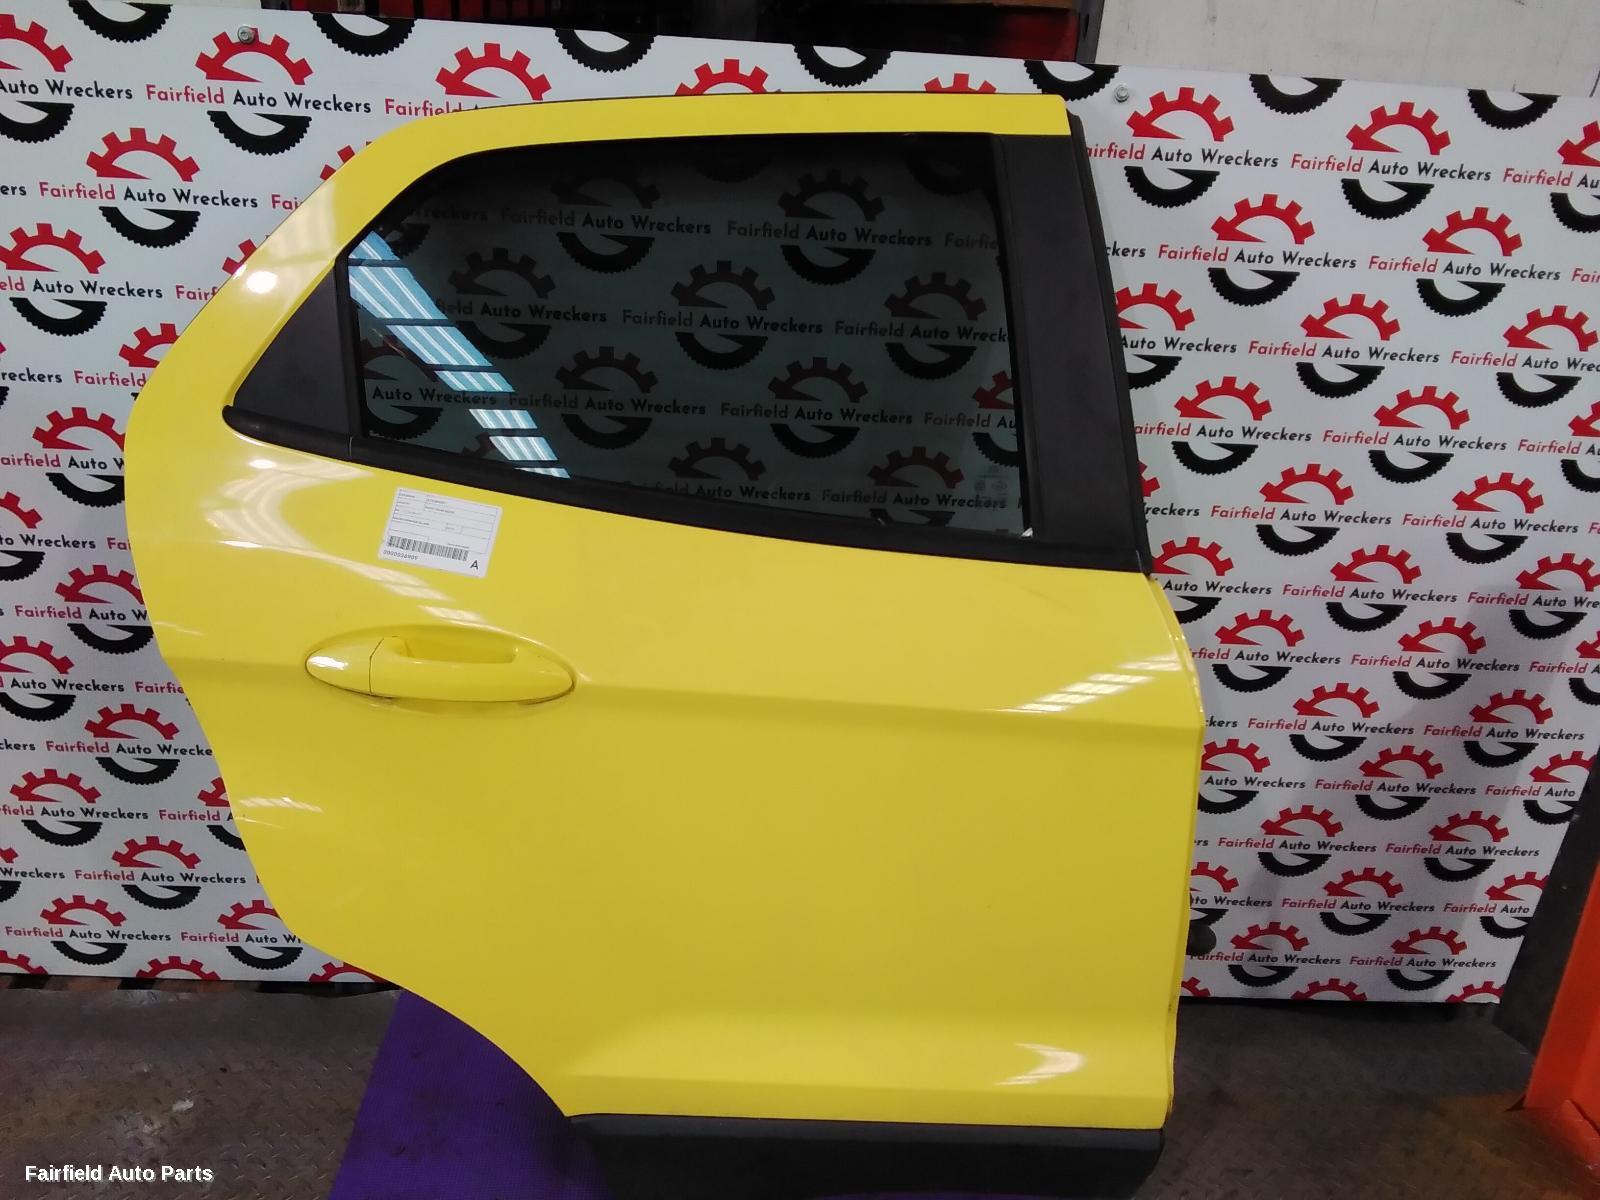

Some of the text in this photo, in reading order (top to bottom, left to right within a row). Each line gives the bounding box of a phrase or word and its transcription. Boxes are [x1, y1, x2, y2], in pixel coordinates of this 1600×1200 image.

[45, 79, 132, 99] Wreckers
[146, 84, 371, 113] Fairfield Auto Wreckers
[1151, 146, 1192, 162] Auto
[1202, 148, 1278, 167] Wreckers
[1291, 154, 1491, 181] Fairfield Auto Wreckers
[1503, 168, 1573, 186] Fairfield
[39, 182, 115, 200] Fairfield
[124, 186, 166, 203] Auto
[173, 188, 258, 208] Wreckers
[582, 212, 624, 229] Auto
[631, 215, 711, 234] Wreckers
[806, 225, 847, 242] Auto
[854, 227, 933, 246] Wreckers
[1106, 241, 1146, 257] ckers
[1158, 244, 1356, 268] Fairfield Auto Wreckers
[1369, 256, 1438, 272] Fairfield
[1443, 261, 1481, 276] Auto
[1491, 263, 1560, 280] Wreckers
[33, 278, 74, 293] Auto
[80, 280, 163, 298] Wreckers
[480, 302, 607, 323] Auto Wreckers
[623, 309, 823, 334] Fairfield Auto Wreckers
[835, 320, 1006, 342] Fairfield Auto Wreck
[1164, 337, 1237, 353] Wreckers
[1249, 341, 1439, 362] Fairfield Auto Wreckers
[1451, 351, 1558, 369] Fairfield Auto
[1, 367, 62, 383] reckers
[372, 386, 412, 400] Auto
[584, 396, 624, 411] Auto
[629, 398, 706, 414] Wreckers
[794, 406, 832, 421] Auto
[840, 408, 912, 424] Wreckers
[1135, 421, 1312, 441] airfield Auto Wreckers
[1323, 430, 1507, 450] Fairfield Auto Wreckers
[1518, 439, 1582, 454] Fairfield
[1, 453, 61, 467] airfield
[68, 456, 107, 469] Auto
[739, 485, 811, 501] Wreckers
[893, 493, 930, 506] Auto
[1143, 503, 1200, 517] reckers
[1211, 505, 1391, 524] Fairfield Auto Wreckers
[1403, 514, 1466, 528] Fairfield
[1471, 518, 1506, 529] Auto
[1514, 519, 1578, 533] Wreckers
[19, 534, 96, 549] Wreckers
[470, 560, 479, 570] A
[1163, 579, 1272, 594] Auto Wreckers
[1283, 584, 1457, 602] Fairfield Auto Wreckers
[1468, 592, 1528, 605] Fairfield
[1533, 595, 1566, 607] Auto
[15, 605, 82, 619] Fairfield
[89, 608, 126, 621] Auto
[1190, 648, 1341, 664] rfield Auto Wreckers
[1351, 654, 1520, 671] Fairfield Auto Wreckers
[1529, 661, 1587, 673] Fairfield
[11, 678, 47, 690] Auto
[51, 679, 124, 692] Wreckers
[135, 681, 184, 693] Fairfie
[1248, 718, 1414, 734] Fairfield Auto Wreckers
[1424, 725, 1584, 740] Fairfield Auto Wreckers
[0, 739, 35, 751] ckers
[46, 741, 212, 756] Fairfield Auto Wrecke
[1205, 776, 1305, 788] Auto Wreckers
[1315, 779, 1476, 794] Fairfield Auto Wreckers
[1485, 785, 1575, 797] Fairfield Auto
[1, 804, 148, 819] field Auto Wreckers
[159, 810, 220, 821] Fairfield
[1218, 837, 1274, 849] Fairfield
[1279, 840, 1310, 850] Auto
[1317, 841, 1376, 852] Wreckers
[1385, 843, 1539, 857] Fairfield Auto Wreckers
[75, 870, 246, 884] Fairfield Auto Wreckers
[1214, 896, 1272, 907] Wreckers
[1282, 898, 1435, 912] Fairfield Auto Wreckers
[1443, 903, 1530, 914] Fairfield Auto
[5, 926, 171, 941] Fairfield Auto Wreckers
[181, 932, 239, 943] Fairfield
[245, 934, 277, 944] Auto
[1248, 953, 1341, 965] Auto Wreckers
[1349, 956, 1496, 968] Fairfield Auto Wreckers
